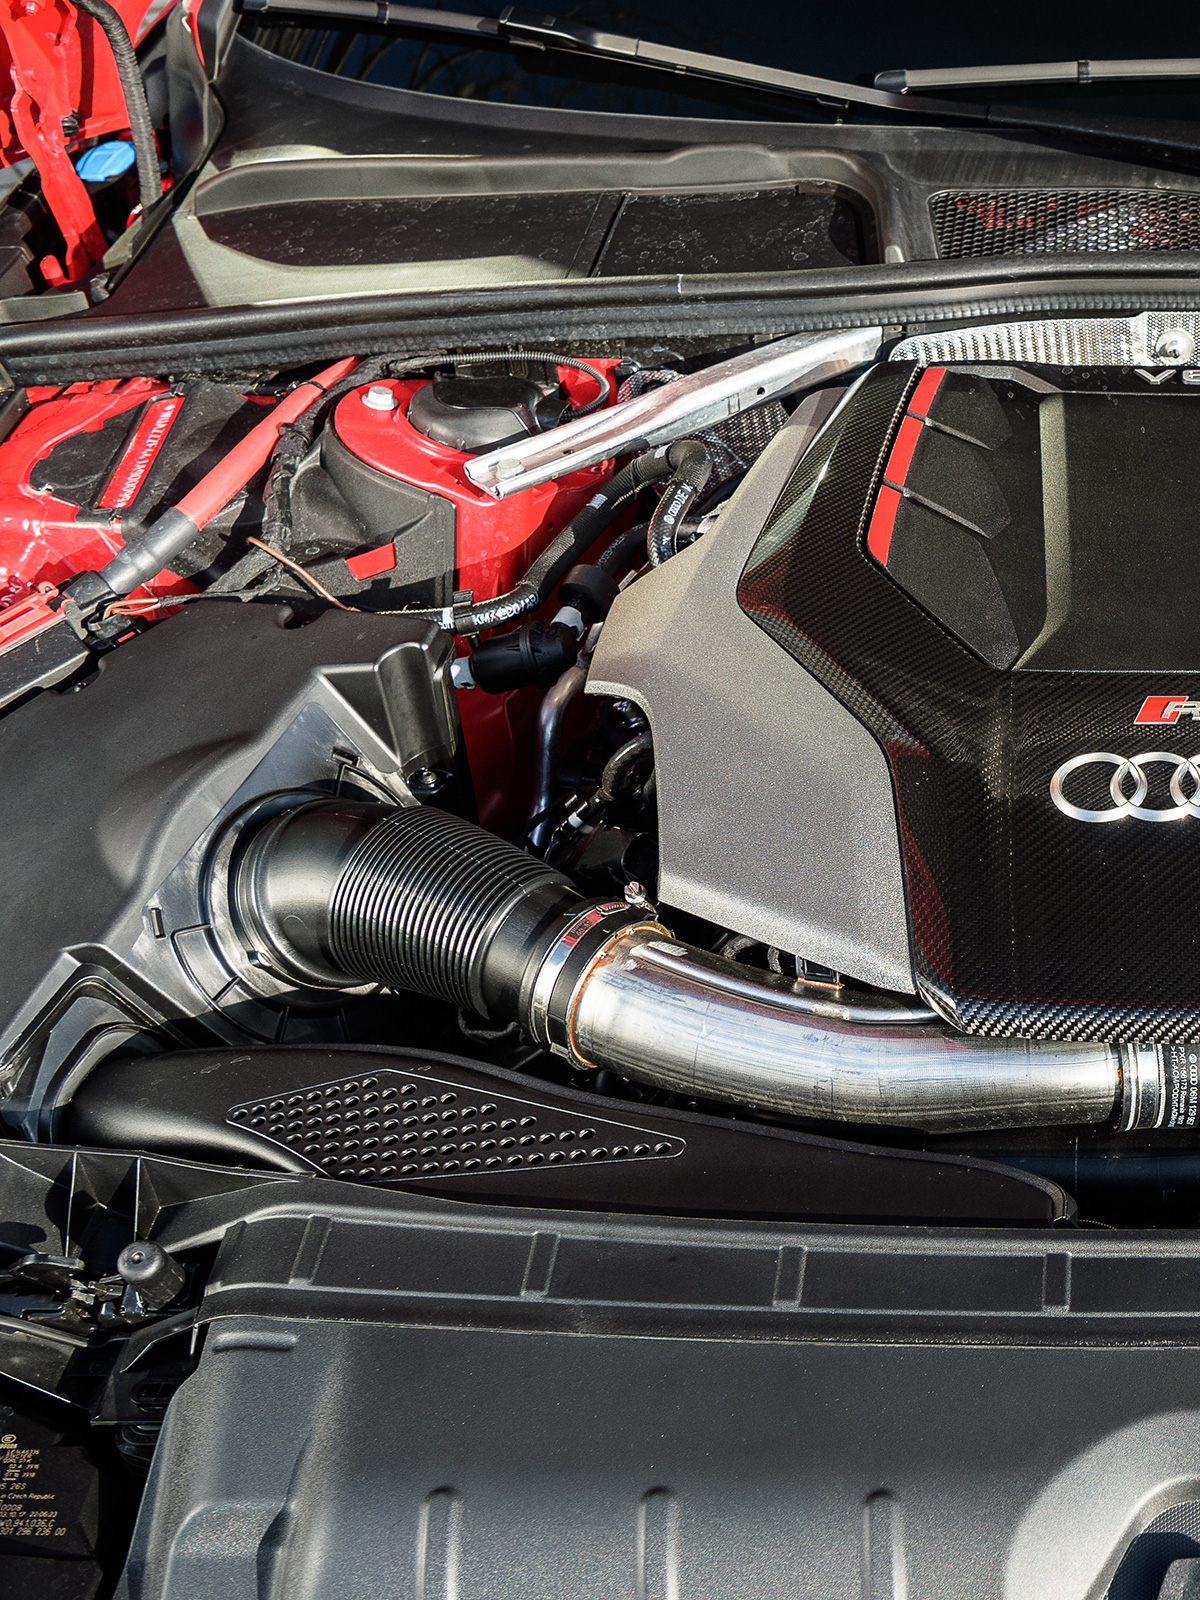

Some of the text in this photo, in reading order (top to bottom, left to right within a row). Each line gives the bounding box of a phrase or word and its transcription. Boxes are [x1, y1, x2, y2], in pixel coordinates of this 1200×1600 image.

[1189, 1087, 1198, 1104] 06M
[0, 1519, 55, 1527] W0.941.036.C
[54, 1527, 67, 1536] 00
